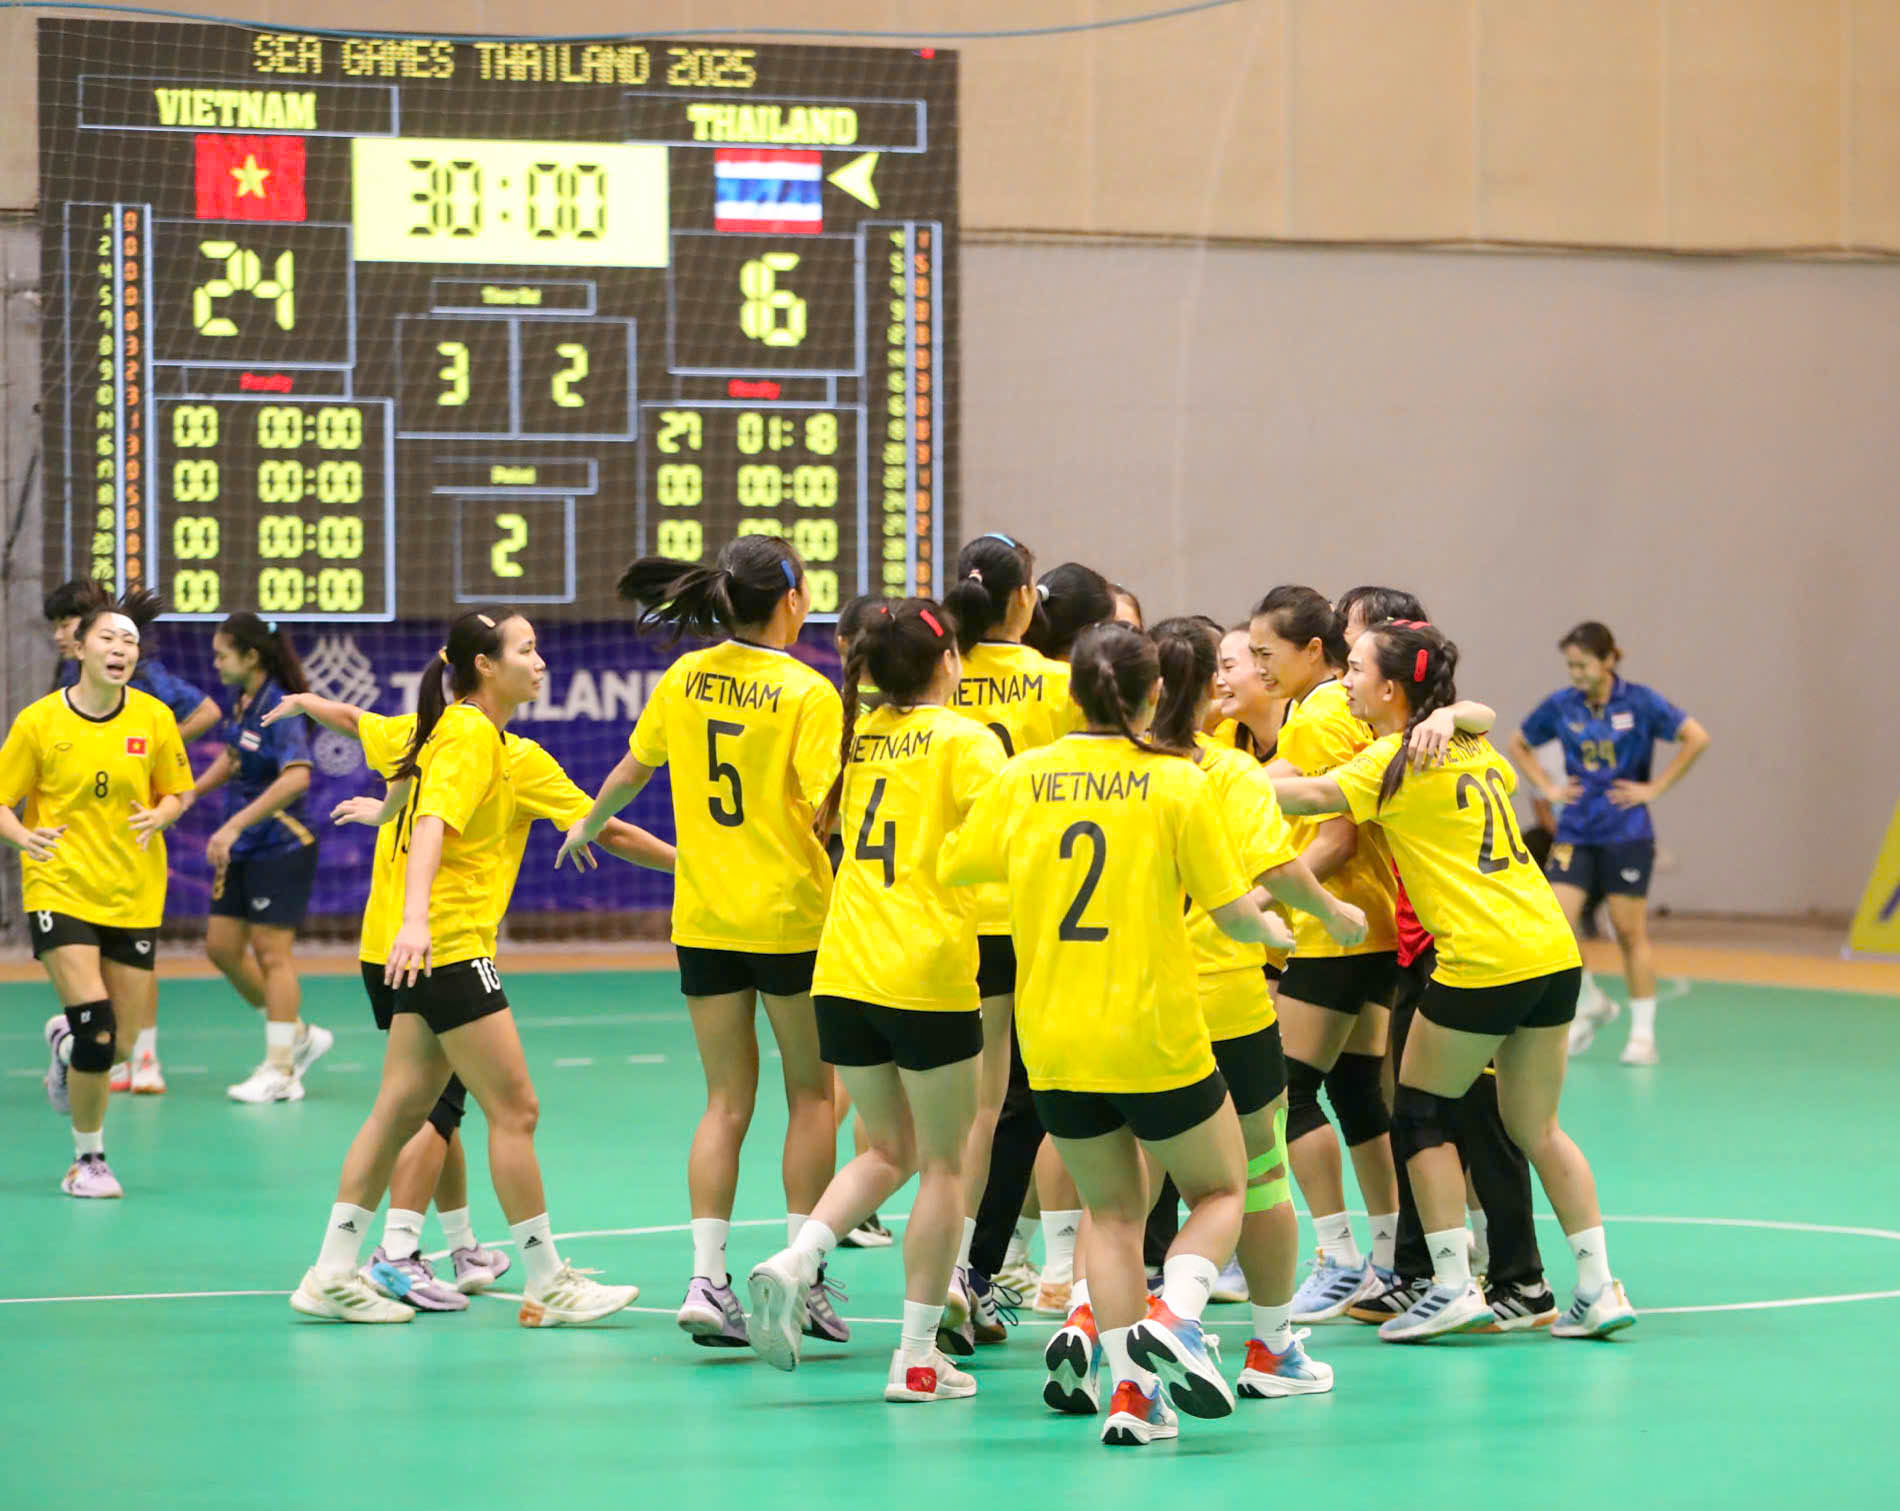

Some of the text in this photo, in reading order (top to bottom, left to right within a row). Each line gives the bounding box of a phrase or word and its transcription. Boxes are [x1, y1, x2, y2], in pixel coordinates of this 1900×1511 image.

[252, 34, 757, 89] SEA GAMES THAILAND 2025
[154, 88, 318, 130] VIETNAM
[686, 103, 859, 146] THAILAND
[408, 159, 606, 240] 30:00
[99, 236, 112, 256] 2
[99, 263, 112, 278] 4
[194, 241, 295, 337] 24
[99, 286, 112, 306] 5
[740, 252, 807, 348] 16
[437, 341, 470, 406] 3
[551, 343, 589, 408] 2
[173, 405, 363, 450] 00 00:00
[173, 460, 363, 505] 00 00:00
[657, 464, 703, 507] 00
[737, 465, 838, 508] 00:00
[173, 516, 363, 561] 00 00:00
[491, 513, 529, 577] 2
[173, 569, 363, 614] 00 00:00
[684, 672, 783, 713] VIETNAM
[953, 673, 1042, 707] IETNAM
[849, 729, 933, 764] IETNAM
[94, 770, 109, 799] 8
[707, 719, 745, 827] 5
[1031, 771, 1150, 802] VIETNAM
[855, 778, 896, 889] 4
[1456, 767, 1530, 875] 20
[1058, 820, 1110, 943] 2
[471, 957, 501, 994] 10
